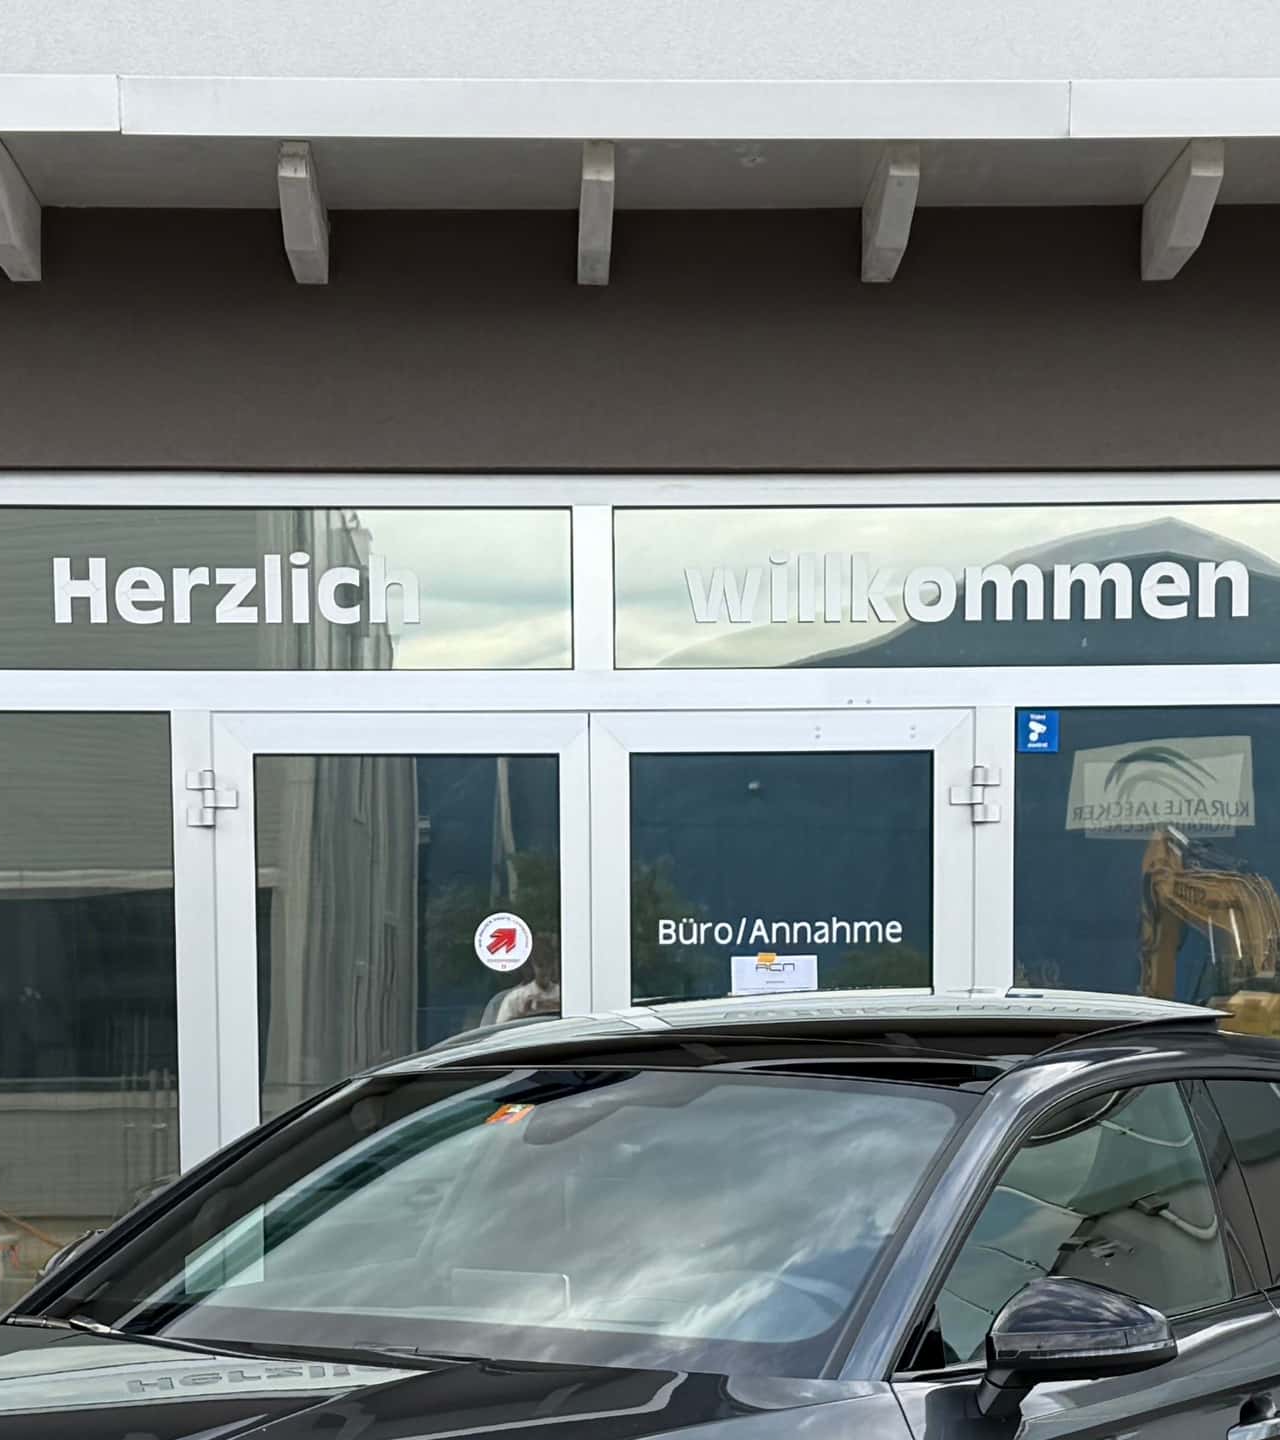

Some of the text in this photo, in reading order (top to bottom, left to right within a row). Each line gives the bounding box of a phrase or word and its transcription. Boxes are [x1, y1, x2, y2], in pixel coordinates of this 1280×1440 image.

[53, 551, 1251, 625] Herzlich willkommen
[658, 917, 903, 945] Büro/Annahme
